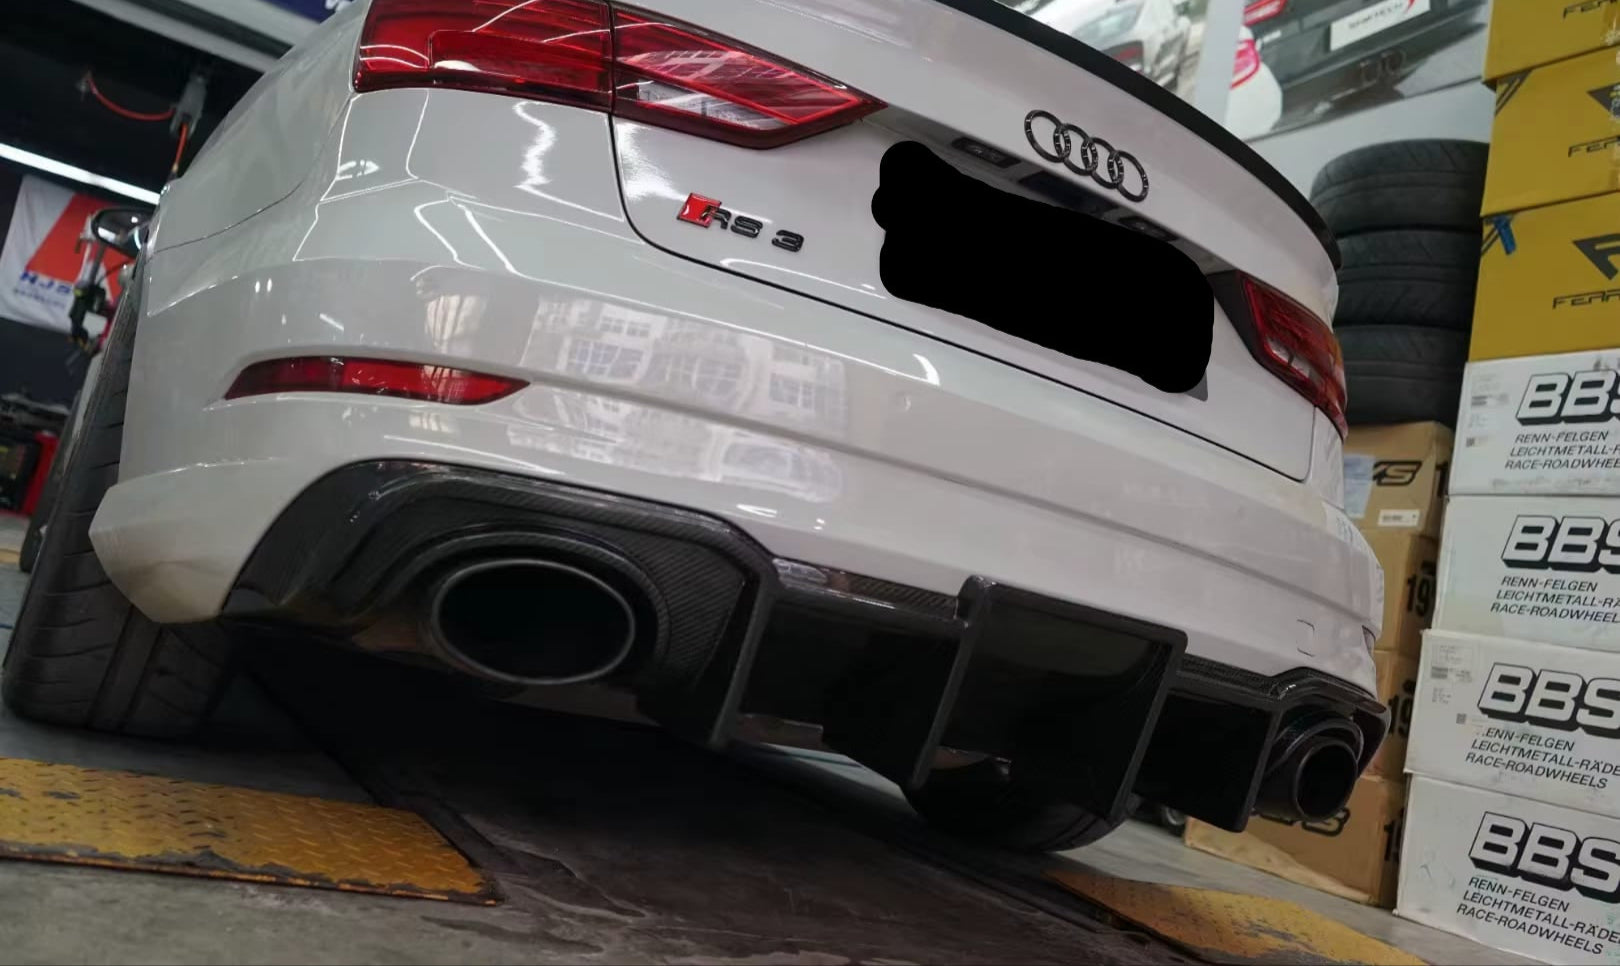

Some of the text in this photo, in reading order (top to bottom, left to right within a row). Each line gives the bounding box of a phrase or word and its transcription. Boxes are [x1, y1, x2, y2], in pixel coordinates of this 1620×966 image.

[690, 198, 805, 253] RS 3
[1515, 369, 1620, 426] BB
[1510, 443, 1620, 458] LEICHTMETALL-R
[1514, 430, 1609, 444] RENN-FELGEN
[1504, 457, 1620, 470] RACE-ROADWHEE
[1500, 575, 1599, 593] RENN-FELGEN
[1490, 602, 1620, 624] RACE-ROADWHEEL
[1477, 662, 1620, 739] BBS
[1471, 738, 1620, 777] LEICHTMETALL-RÄDE
[1482, 727, 1575, 752] ENN-FELGEN
[1465, 751, 1608, 789] RACE-ROADWHEELS
[1468, 811, 1620, 905] BBS
[1468, 876, 1570, 912] RENN-FELGEN
[1456, 903, 1604, 955] RACE-ROADWHEELS
[1463, 890, 1620, 945] LEICHTMETALL-RÄDE
